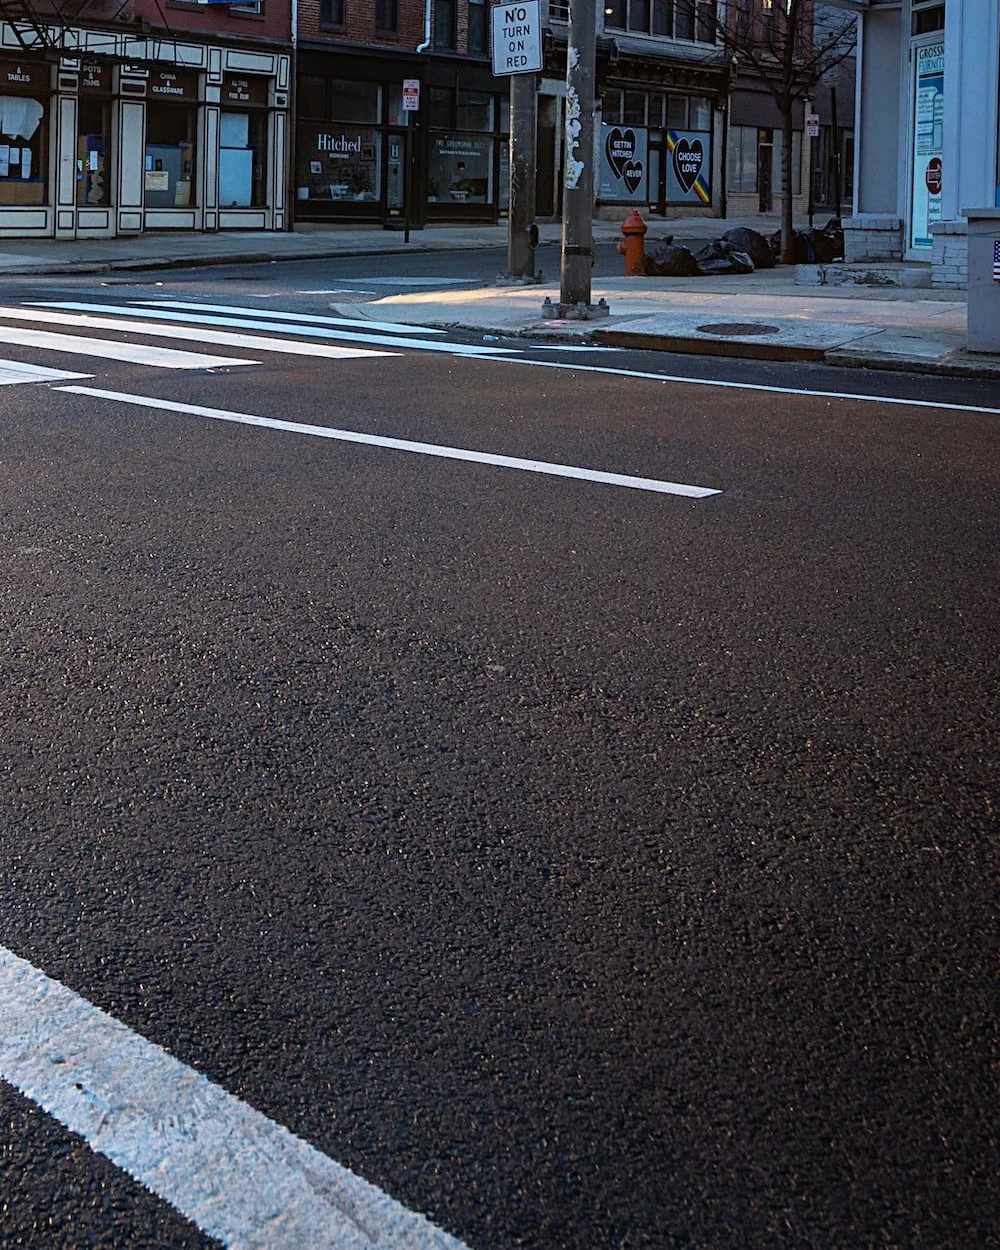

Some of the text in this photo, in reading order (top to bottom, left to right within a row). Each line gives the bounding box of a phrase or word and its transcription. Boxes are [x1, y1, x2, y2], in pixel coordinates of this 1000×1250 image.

[505, 8, 527, 24] NO
[502, 25, 531, 39] TURN
[508, 40, 525, 53] ON
[506, 55, 528, 68] RED
[83, 65, 102, 73] POTS
[7, 73, 31, 82] TABLES
[317, 133, 361, 153] Hitched
[611, 151, 632, 159] HITCHED
[678, 152, 701, 162] CHOOSE
[681, 163, 697, 173] LOVE
